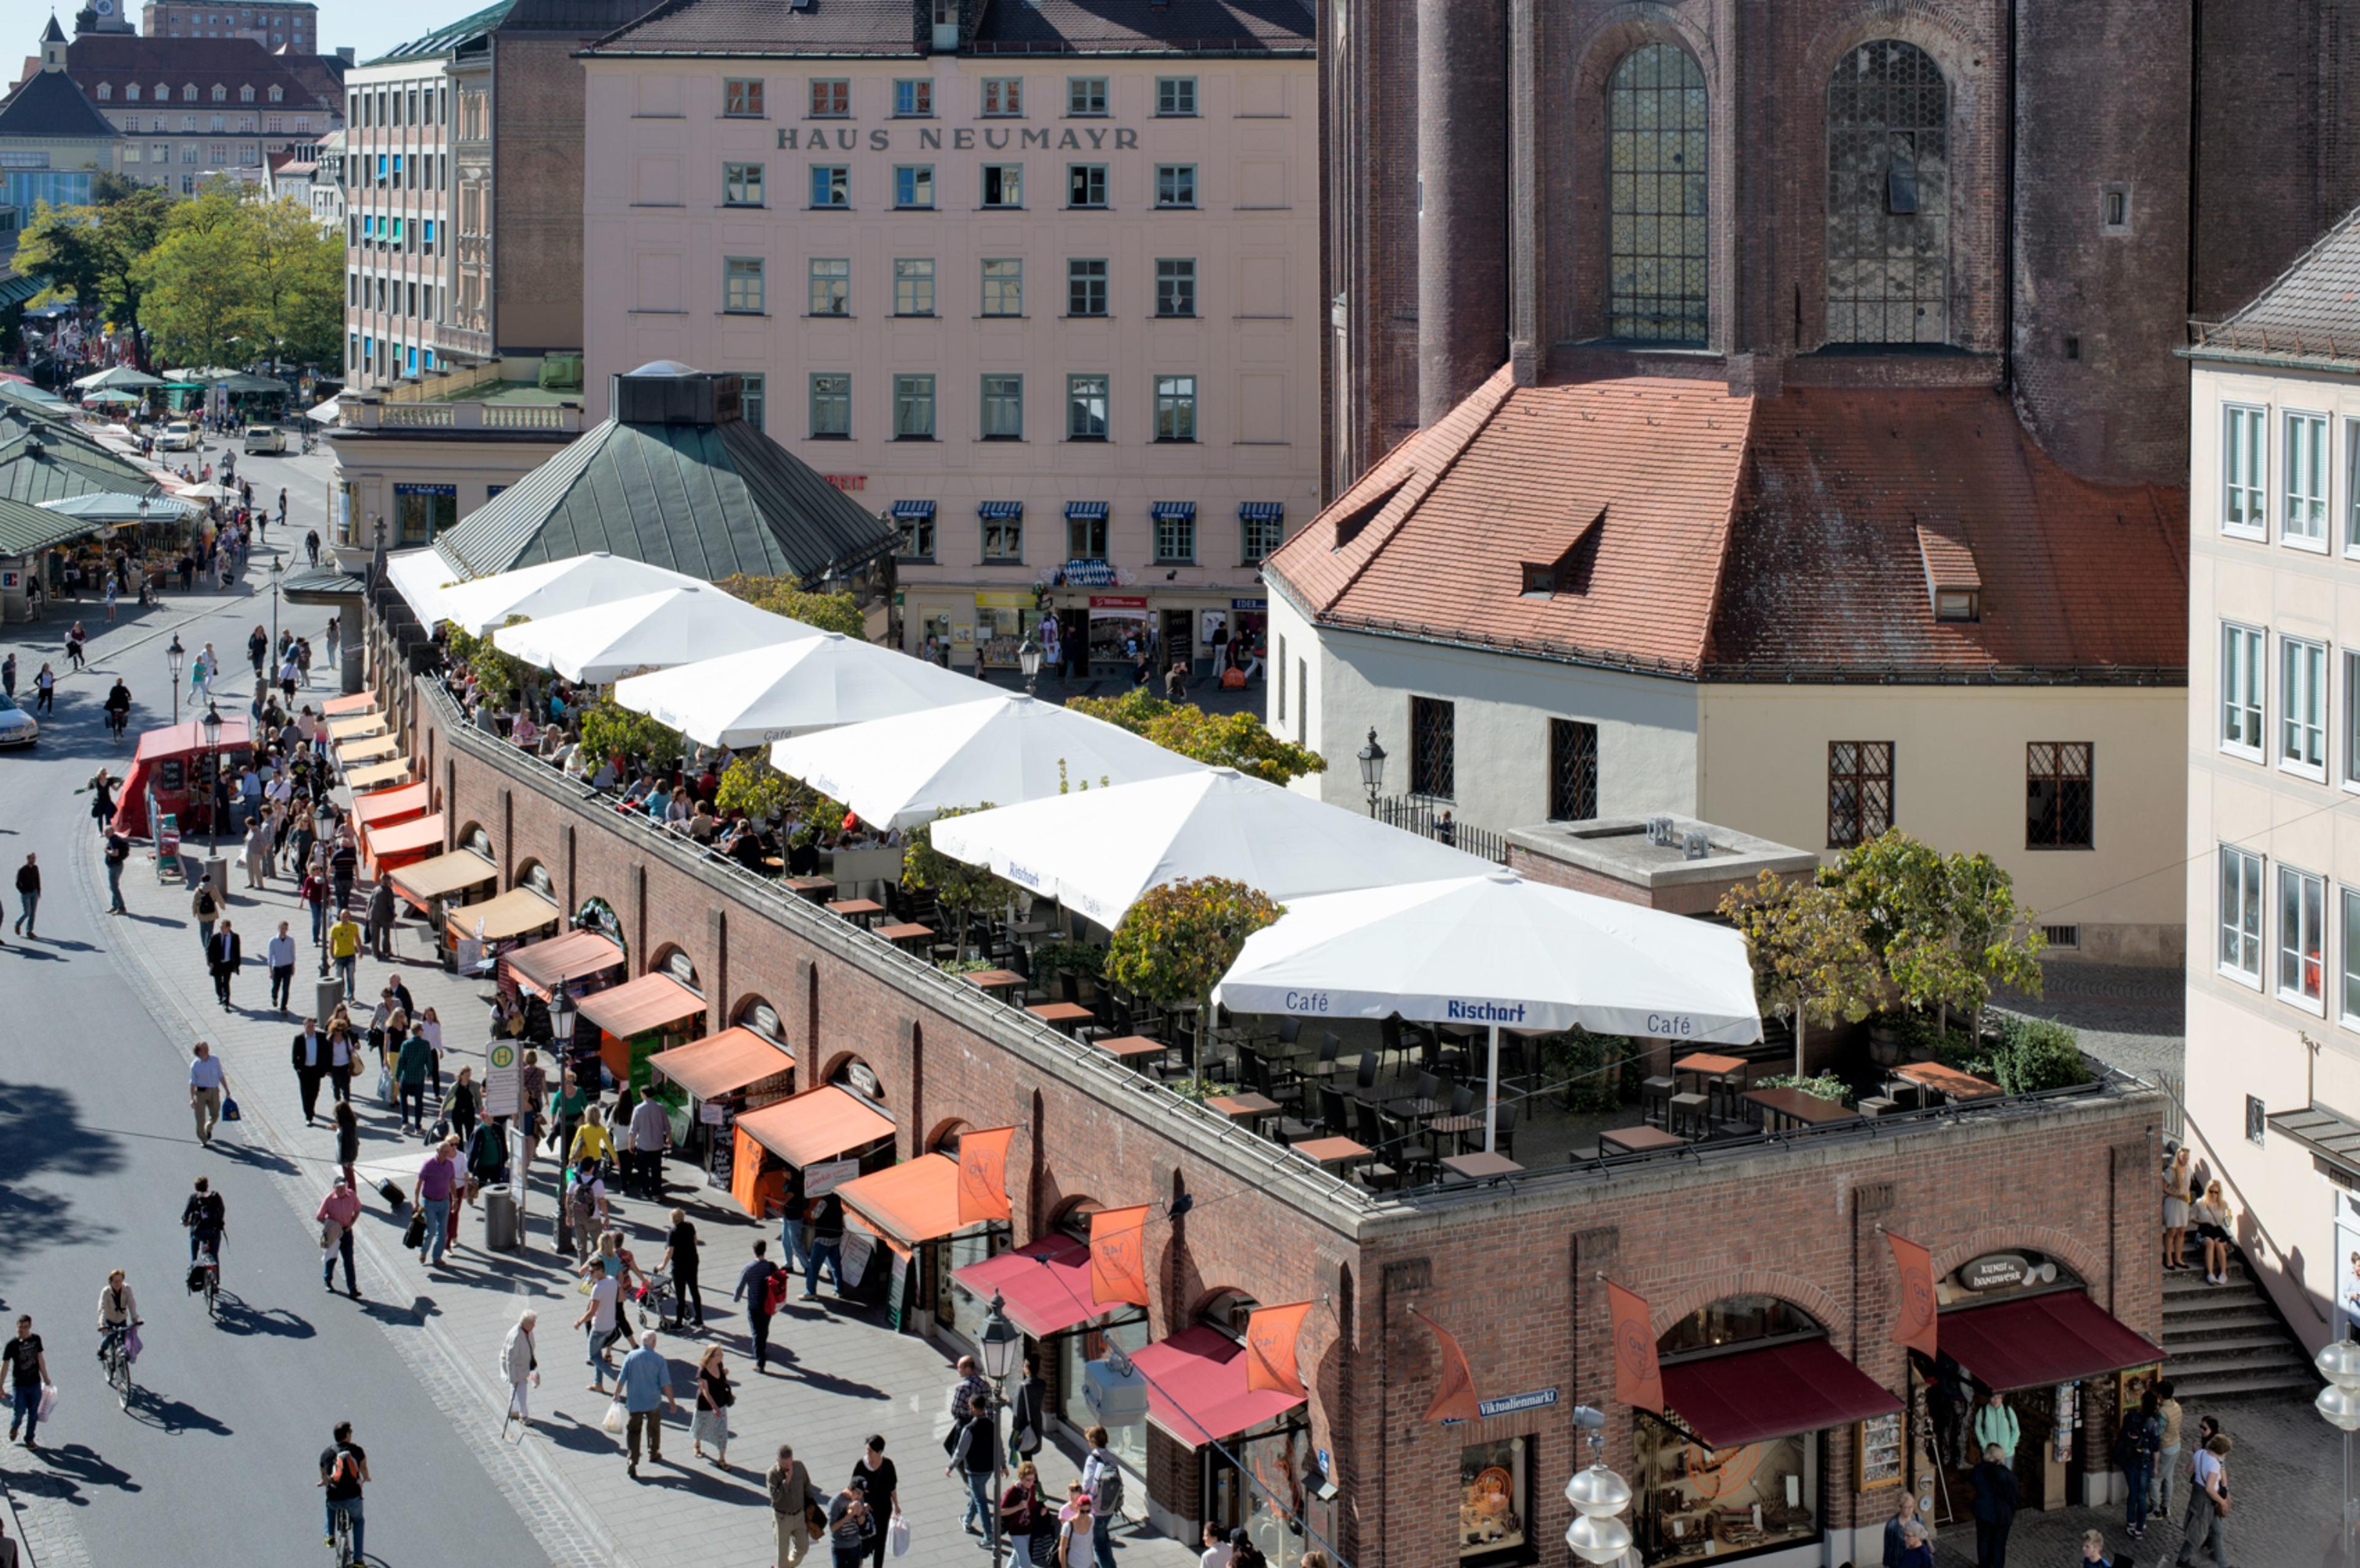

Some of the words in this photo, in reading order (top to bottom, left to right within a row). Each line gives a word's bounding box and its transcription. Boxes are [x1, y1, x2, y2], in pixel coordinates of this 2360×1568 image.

[777, 128, 890, 151] HAUS
[919, 128, 1139, 150] NEUMAYR
[764, 729, 792, 741] Café
[1009, 860, 1040, 888] Rischart
[1286, 992, 1329, 1012] Café
[1448, 1000, 1526, 1022] Rischart
[1648, 1014, 1691, 1035] Café
[498, 1050, 507, 1063] H
[1480, 1391, 1554, 1416] Viktualienmarkt
